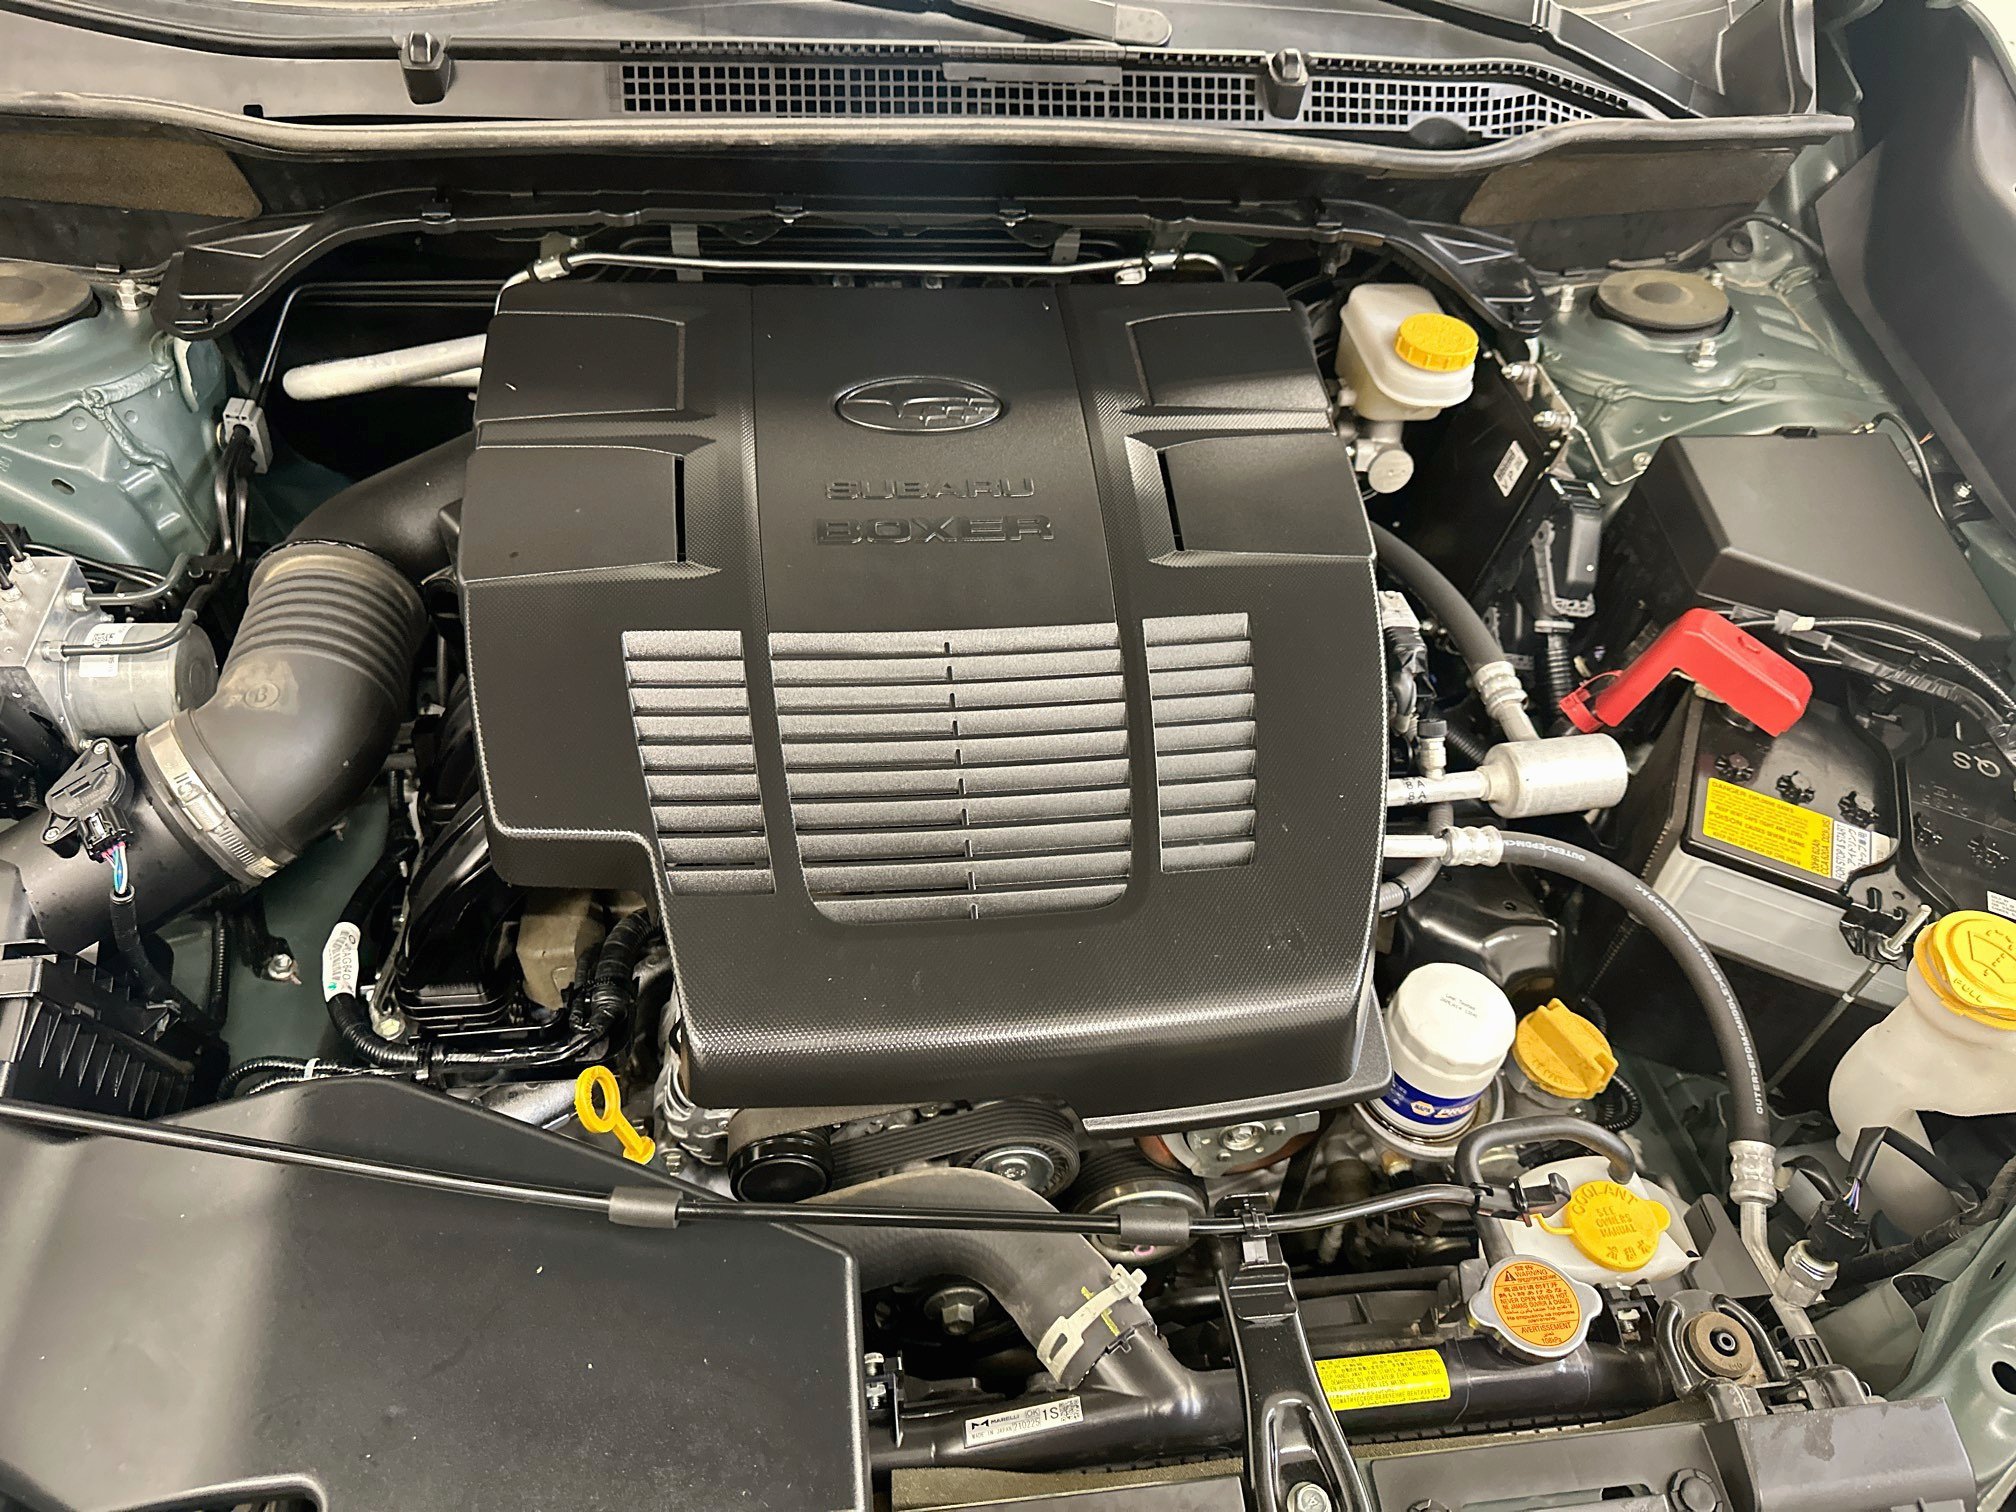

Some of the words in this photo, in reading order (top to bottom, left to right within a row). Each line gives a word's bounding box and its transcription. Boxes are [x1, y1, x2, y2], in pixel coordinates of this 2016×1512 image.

[825, 476, 1036, 500] SUBARU
[815, 514, 1054, 544] BOXER
[1712, 782, 1747, 796] DANGER
[1709, 810, 1742, 826] POISON
[1836, 823, 1846, 844] START
[1836, 849, 1846, 865] STOP
[1835, 865, 1845, 879] FOR
[1414, 1103, 1431, 1113] NAPA
[1572, 1184, 1638, 1215] COOLANT
[1597, 1205, 1616, 1217] SEE
[1600, 1223, 1637, 1238] MANUAL
[1514, 1269, 1548, 1277] WARNING
[1500, 1296, 1519, 1304] NEVER
[1521, 1295, 1536, 1303] OPEN
[1537, 1293, 1554, 1301] WHEN
[1521, 1321, 1571, 1334] AVERTISSEMENT
[991, 1414, 1020, 1425] MARELLI
[1027, 1408, 1040, 1418] OK
[972, 1431, 985, 1439] MADE
